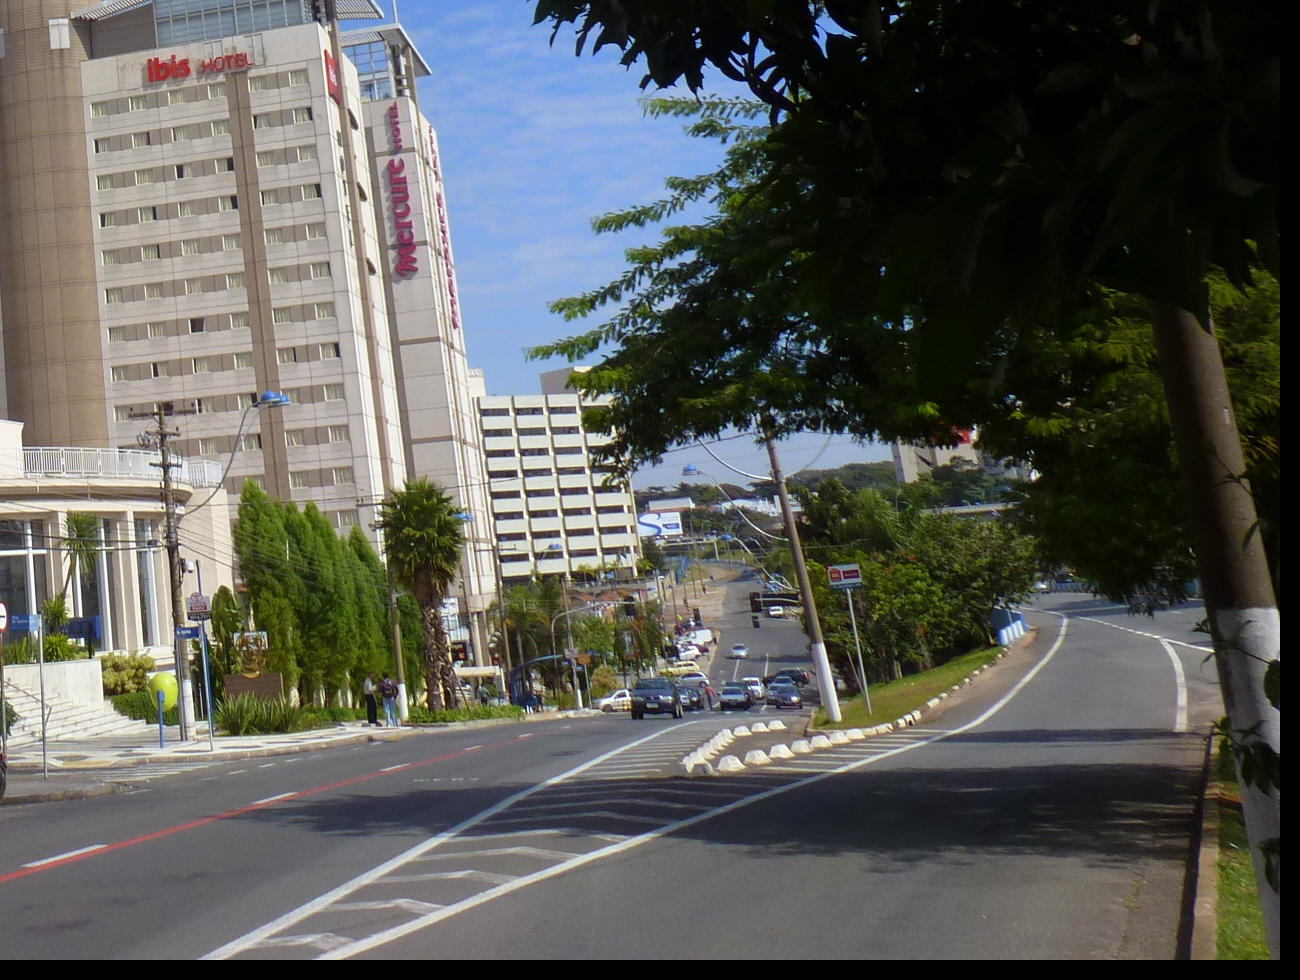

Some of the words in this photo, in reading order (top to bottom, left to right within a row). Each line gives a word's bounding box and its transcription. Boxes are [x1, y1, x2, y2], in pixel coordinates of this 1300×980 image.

[147, 54, 190, 82] ibis
[202, 52, 254, 73] HOTEL
[389, 101, 403, 151] HOTEL
